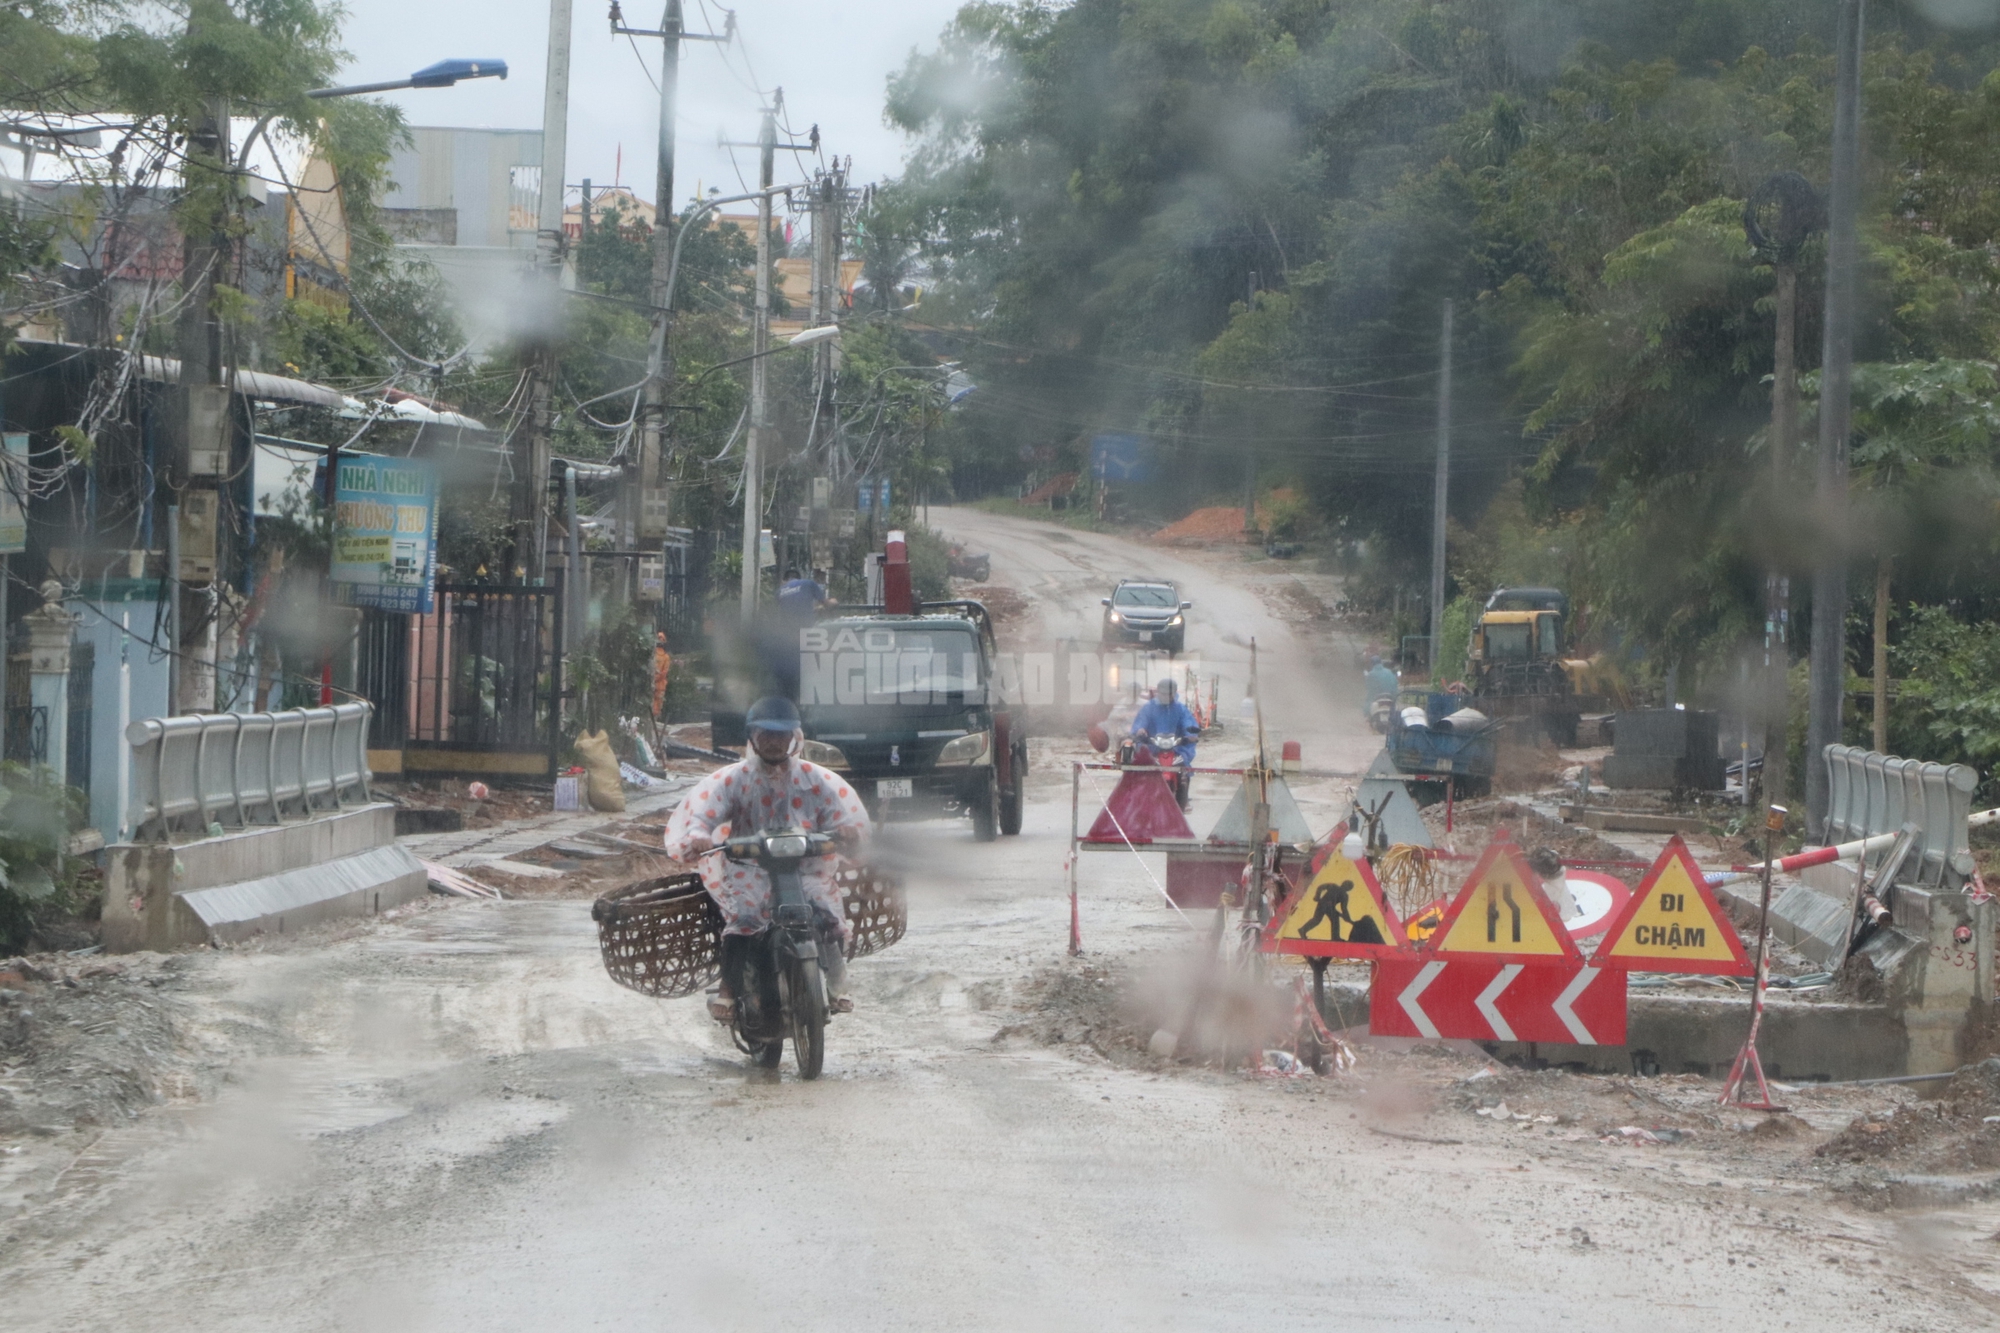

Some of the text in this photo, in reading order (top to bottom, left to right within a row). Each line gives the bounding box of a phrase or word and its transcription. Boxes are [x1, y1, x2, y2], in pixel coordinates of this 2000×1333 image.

[341, 462, 377, 492] NHÀ
[400, 586, 418, 598] 240
[1660, 893, 1684, 913] ĐI
[1635, 922, 1705, 950] CHẬM
